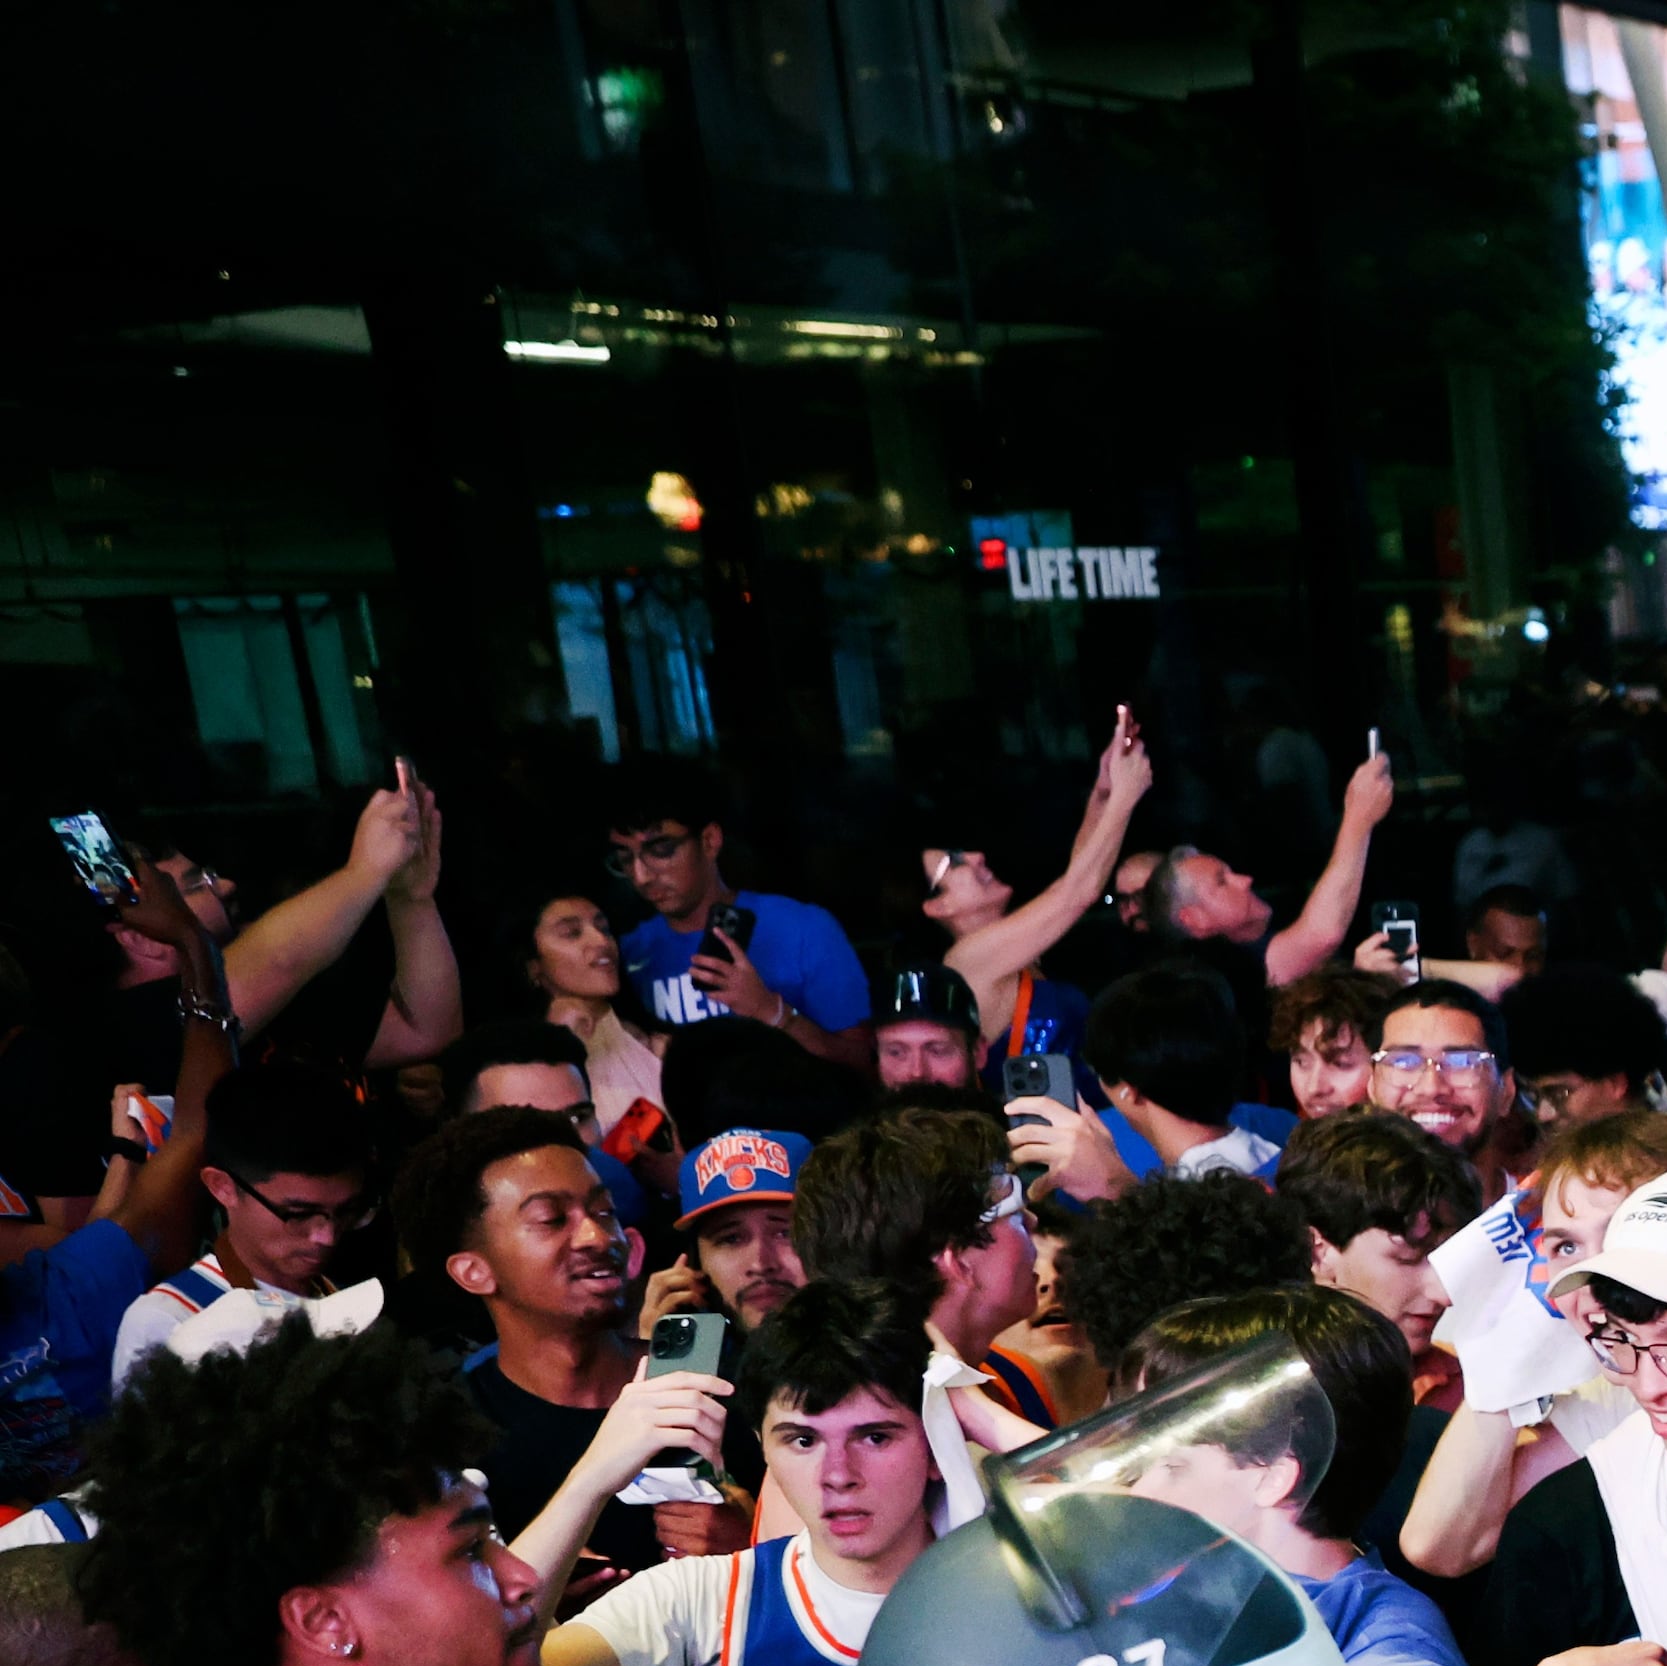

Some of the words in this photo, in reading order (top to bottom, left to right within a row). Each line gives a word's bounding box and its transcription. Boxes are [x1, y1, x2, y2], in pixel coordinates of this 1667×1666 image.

[1007, 547, 1079, 601] LIFE
[1077, 546, 1161, 599] TIME
[694, 1136, 791, 1196] KNICKS
